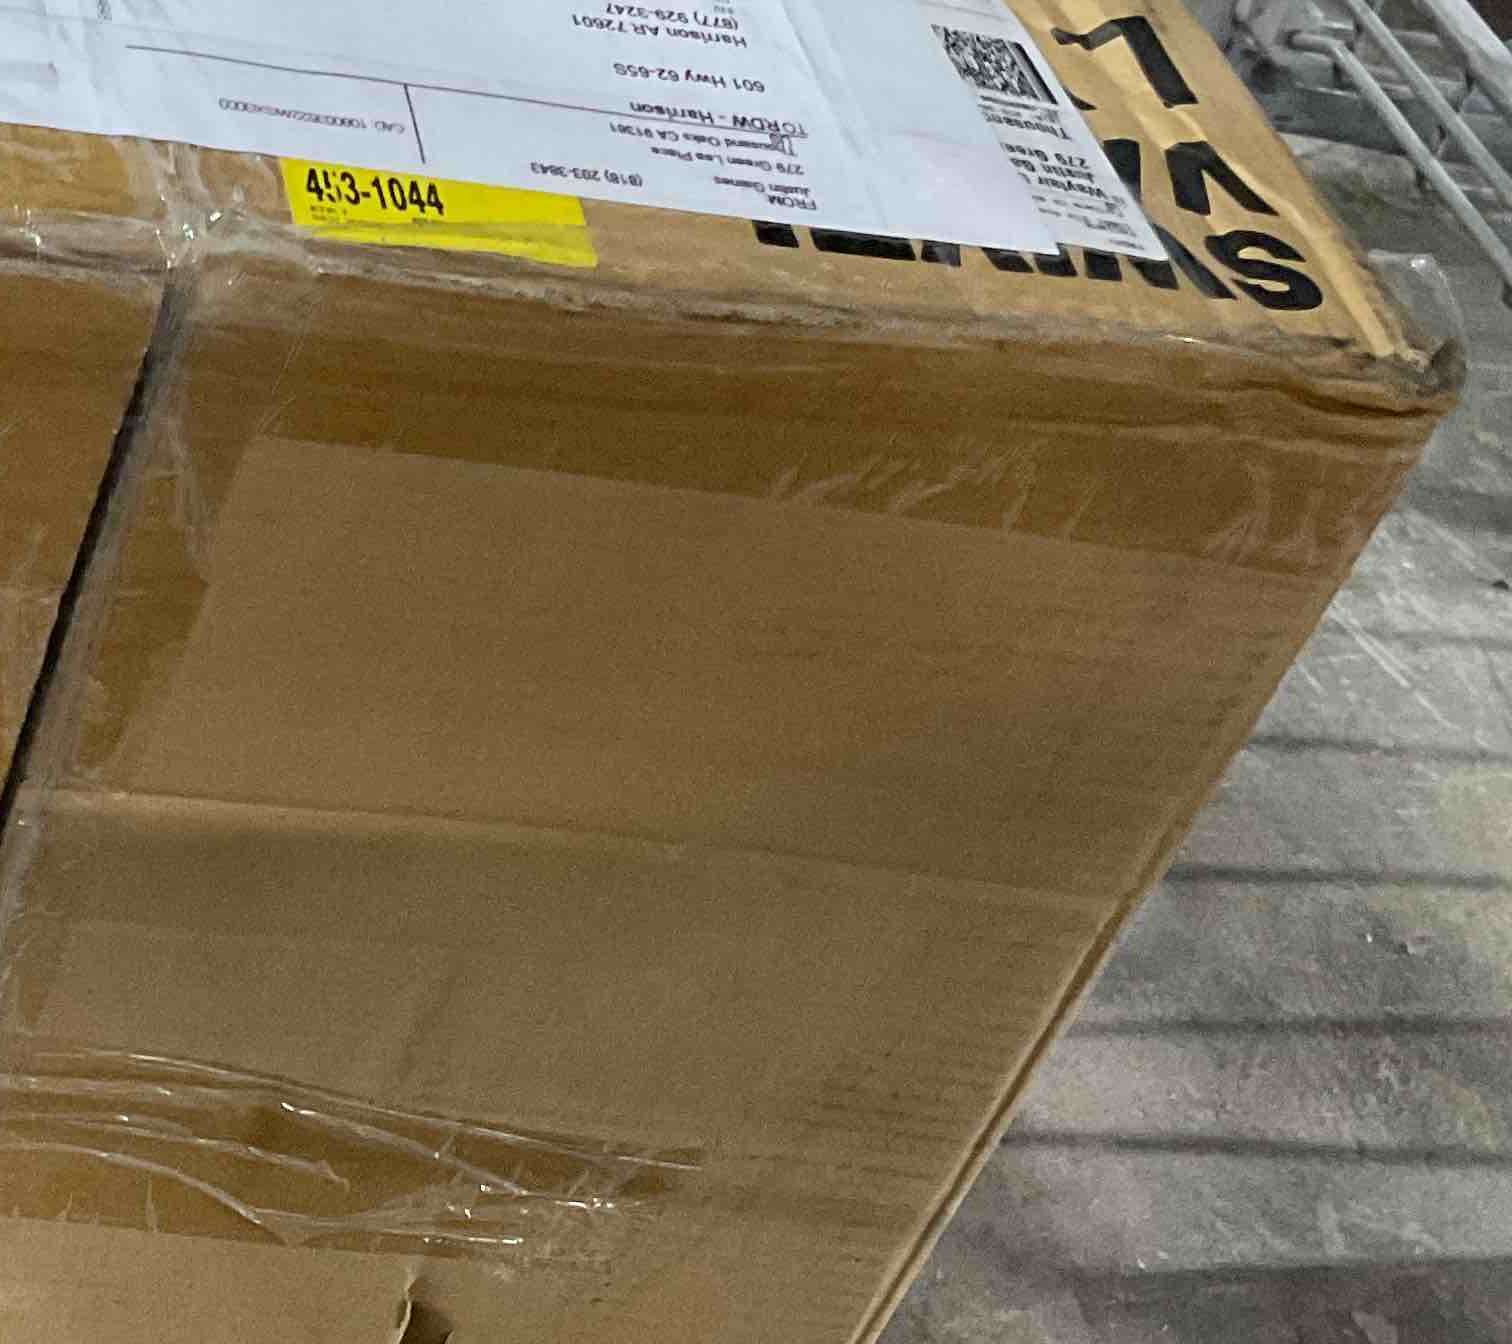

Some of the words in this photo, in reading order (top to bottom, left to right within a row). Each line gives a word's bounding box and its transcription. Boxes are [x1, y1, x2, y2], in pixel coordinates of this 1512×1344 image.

[570, 15, 626, 32] 72601
[692, 11, 739, 30] (877)
[632, 24, 659, 38] AR
[663, 28, 747, 48] Harrison
[683, 69, 726, 88] Hwy
[733, 76, 765, 92] 601
[629, 102, 714, 124] Harrison
[776, 162, 804, 175] 279
